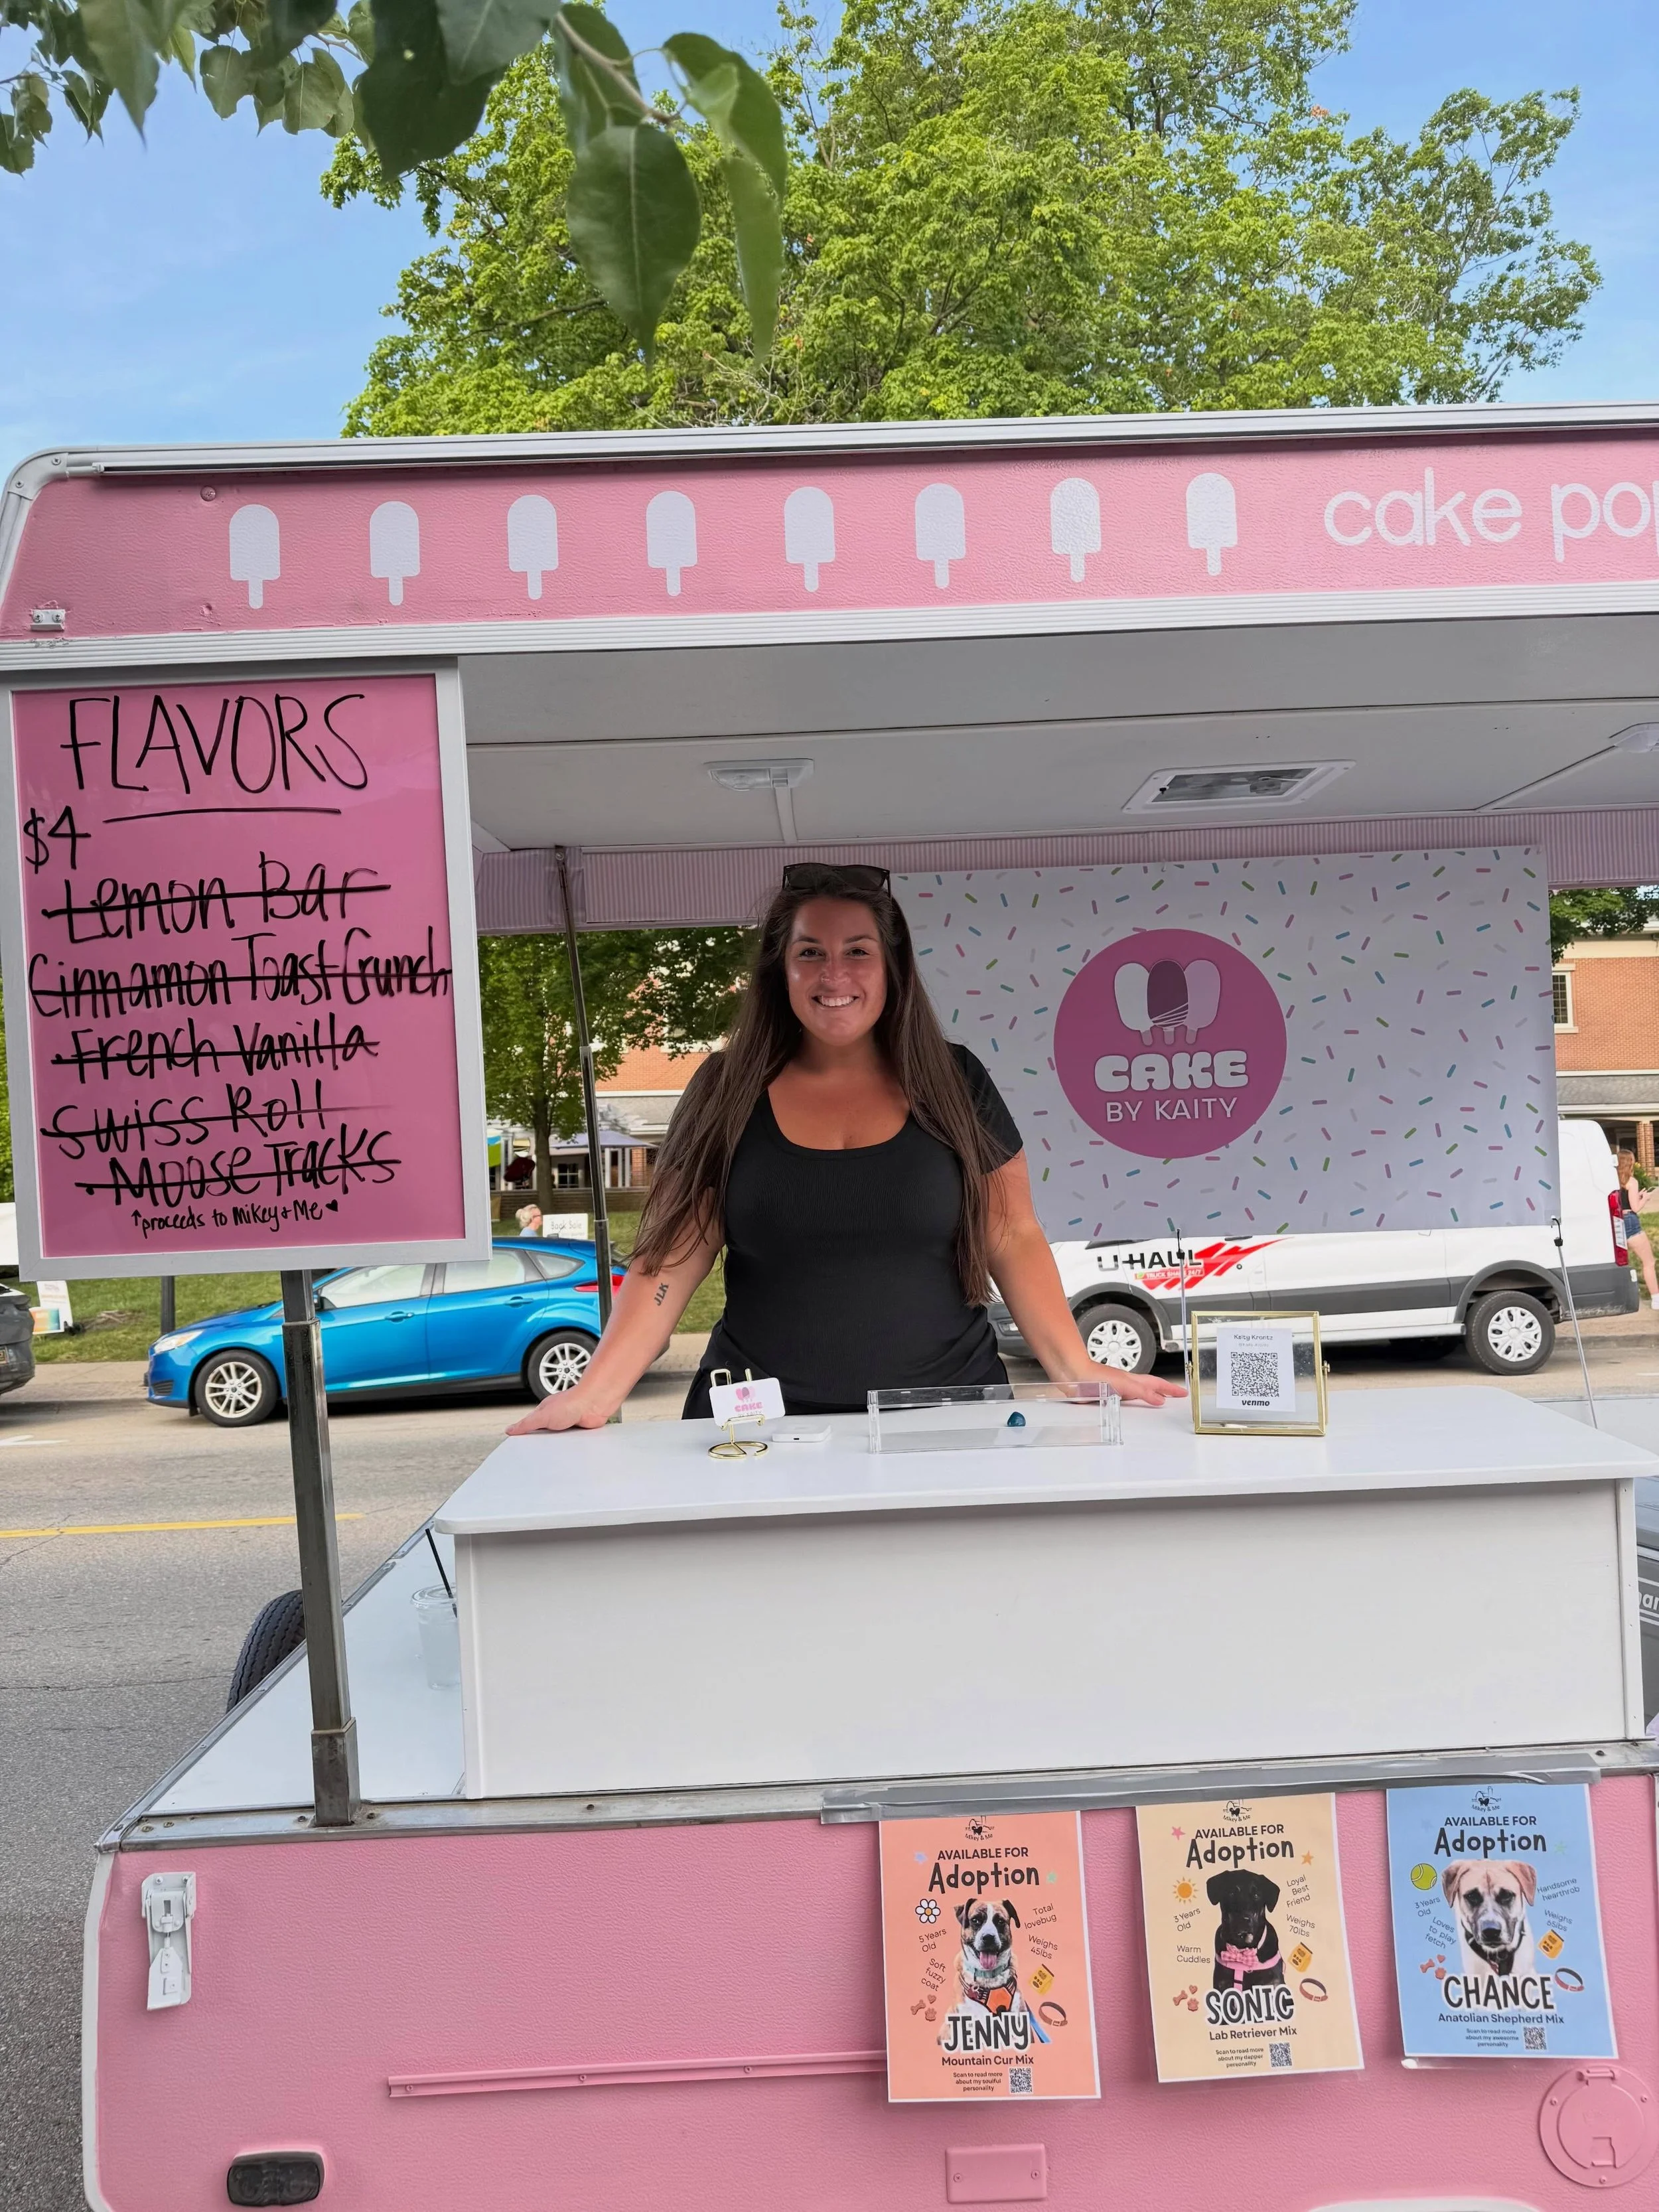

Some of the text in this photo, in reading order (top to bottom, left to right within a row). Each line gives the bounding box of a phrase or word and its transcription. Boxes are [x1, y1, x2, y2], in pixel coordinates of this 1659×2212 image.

[1324, 467, 1522, 546] cake
[60, 694, 368, 794] FLAVORS
[23, 805, 91, 874] $4
[64, 850, 378, 943] Lemon Bar
[29, 926, 450, 1019] Cinnamon Toast Crunch
[70, 1012, 379, 1084] French Vanilla
[1094, 1050, 1248, 1092] CAKE
[1106, 1096, 1238, 1123] BY KAITY
[52, 1078, 325, 1159] Swiss Roll
[109, 1146, 261, 1208] Moose
[141, 1206, 205, 1239] proceeds
[212, 1209, 228, 1227] to
[1097, 1249, 1202, 1272] U-HAUL
[734, 1402, 762, 1412] CAKE
[1445, 1816, 1537, 1826] AVAILABLE FOR
[1195, 1824, 1284, 1839] AVAILABLE FOR
[1434, 1827, 1547, 1858] Adoption
[938, 1847, 1029, 1860] AVAILABLE FOR
[1186, 1837, 1294, 1870] Adoption
[928, 1862, 1039, 1894] Adoption
[1287, 1874, 1306, 1887] Loyal
[1537, 1878, 1577, 1893] Handsome
[1291, 1885, 1309, 1895] Best
[1286, 1893, 1311, 1907] Friend
[1419, 1897, 1441, 1907] Years
[1033, 1903, 1054, 1915] Total
[1179, 1908, 1200, 1920] Years
[1417, 1908, 1431, 1917] Old
[1024, 1915, 1057, 1929] lovebug
[1286, 1914, 1315, 1929] Weighs
[1544, 1909, 1573, 1925] Weighs
[1177, 1921, 1191, 1931] Old
[1289, 1925, 1310, 1937] 70lbs
[1433, 1917, 1455, 1933] Loves
[924, 1929, 947, 1941] Years
[1029, 1934, 1058, 1951] Weighs
[1425, 1933, 1446, 1949] fetch
[1439, 1932, 1457, 1945] play
[922, 1941, 936, 1952] Old
[1031, 1947, 1052, 1959] 45lbs
[929, 1958, 946, 1972] Soft
[1177, 1954, 1210, 1964] Cuddles
[926, 1967, 946, 1984] fuzzy
[921, 1978, 939, 1991] coat
[1444, 1975, 1554, 2010] CHANCE
[1206, 1987, 1294, 2024] SONIC
[1439, 2013, 1565, 2025] Anatolian Shepherd Mix
[944, 2015, 1029, 2051] JENNY
[1210, 2026, 1297, 2040] Lab Retriever Mix
[942, 2054, 1034, 2066] Mountain Cur Mix
